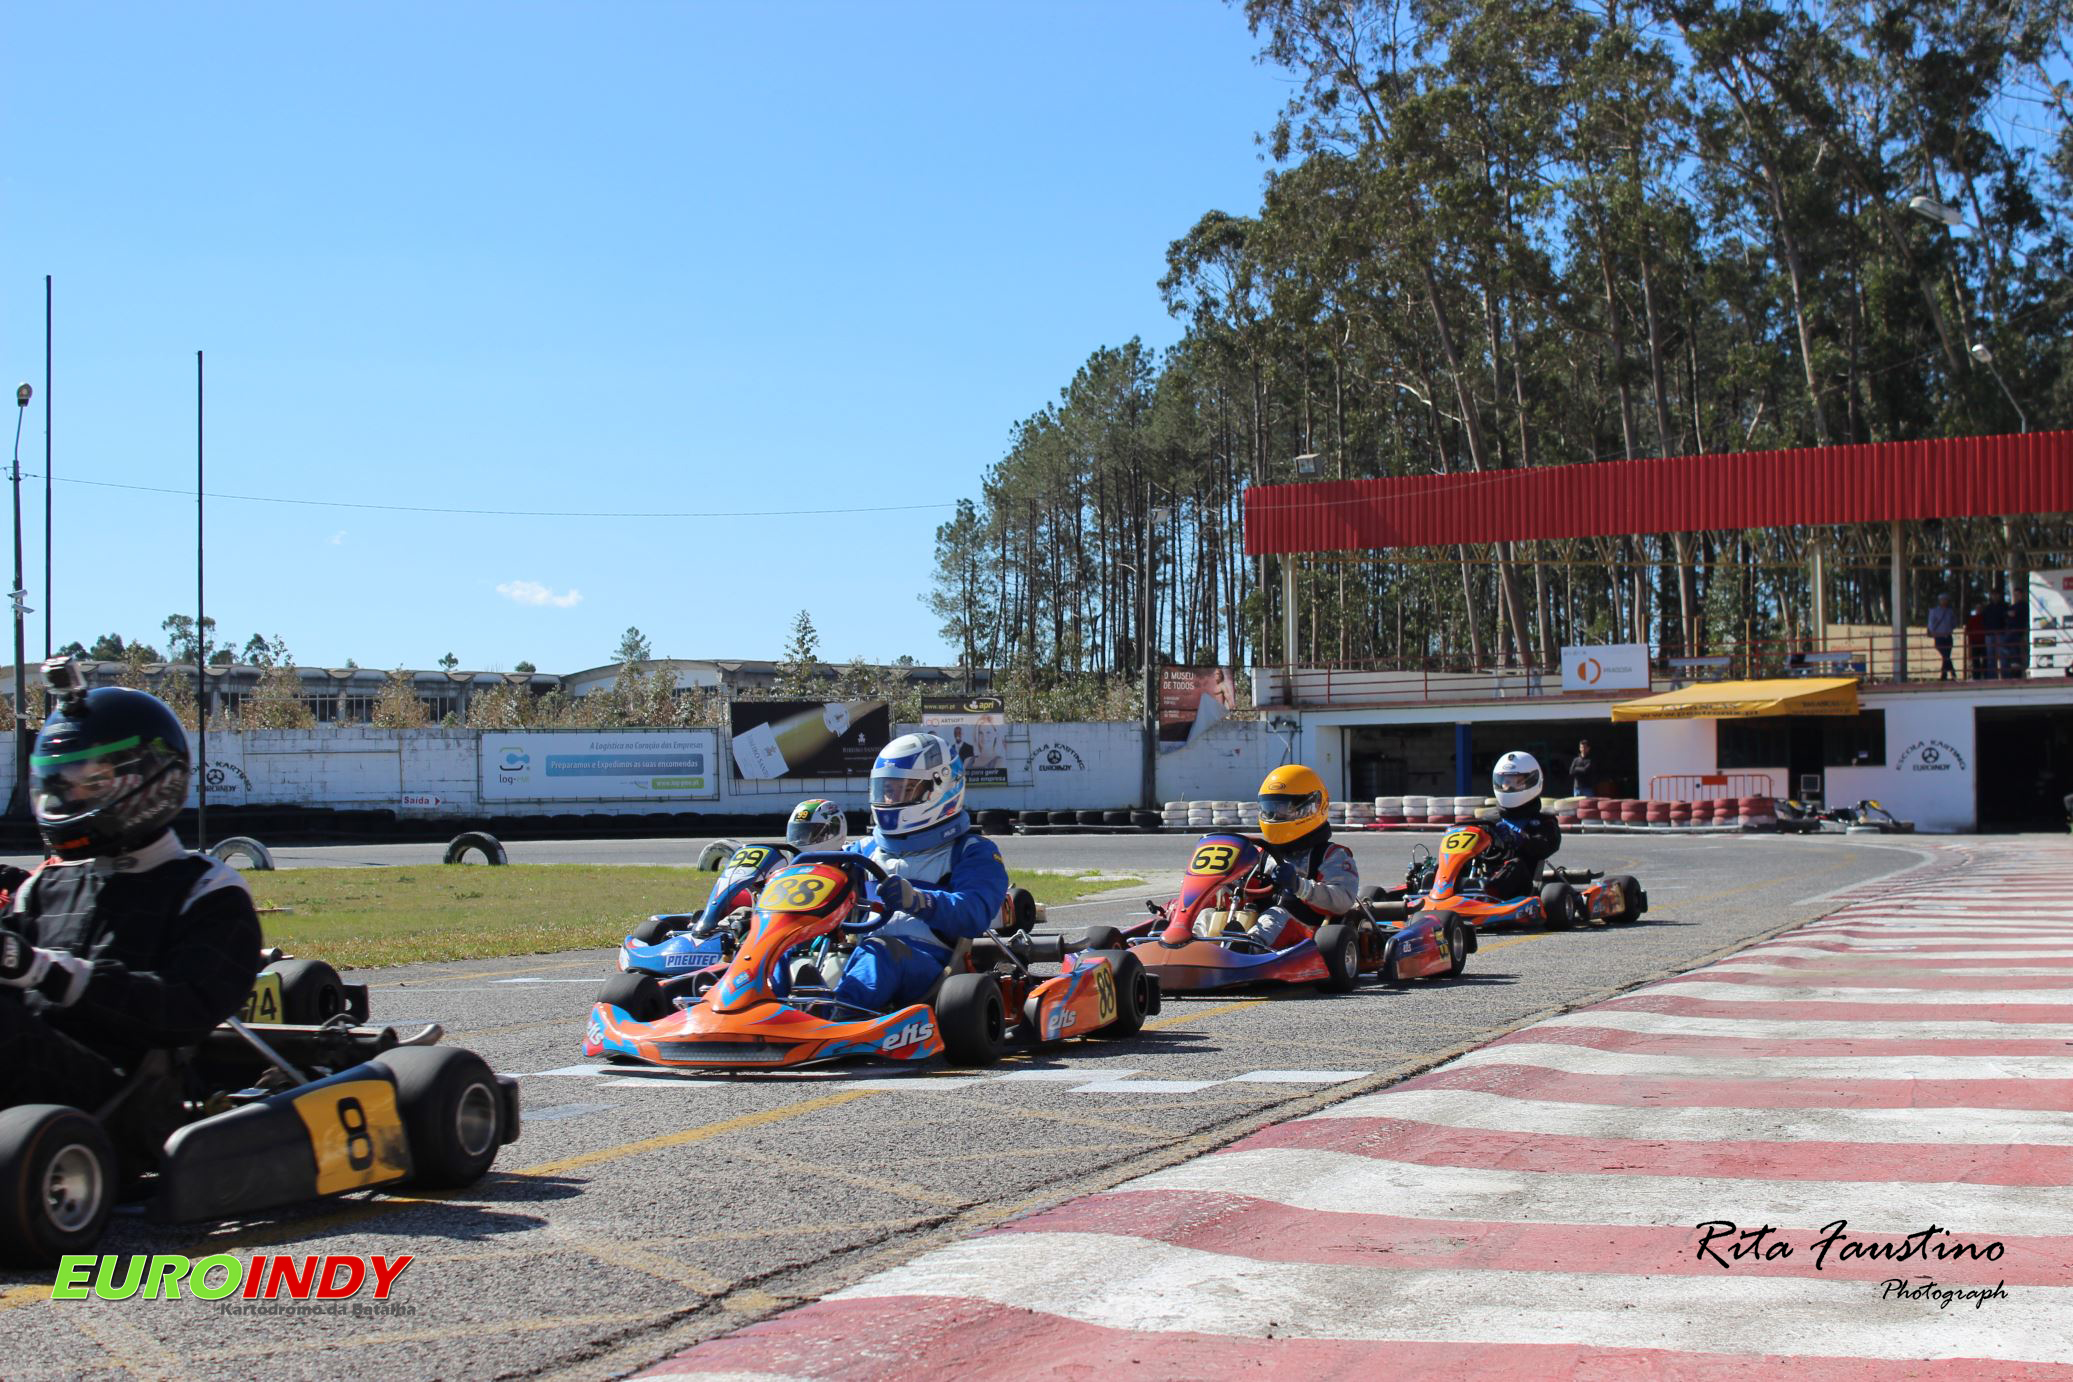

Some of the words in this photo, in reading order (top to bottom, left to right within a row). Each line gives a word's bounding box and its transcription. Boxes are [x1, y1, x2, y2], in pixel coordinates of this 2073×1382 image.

[1163, 671, 1169, 680] O
[1171, 671, 1194, 680] MUSEU
[1163, 681, 1172, 690] DE
[1173, 681, 1195, 690] TODOS
[979, 701, 994, 711] apri
[673, 741, 704, 751] Empresas
[551, 760, 591, 770] Preparamos
[657, 759, 698, 768] encomendas
[403, 795, 430, 804] Saída
[1446, 833, 1477, 849] 67
[1191, 846, 1234, 870] 63
[763, 878, 825, 907] 88
[667, 954, 719, 966] PNEUTEC
[1096, 967, 1115, 1019] 88
[336, 1096, 374, 1172] 8
